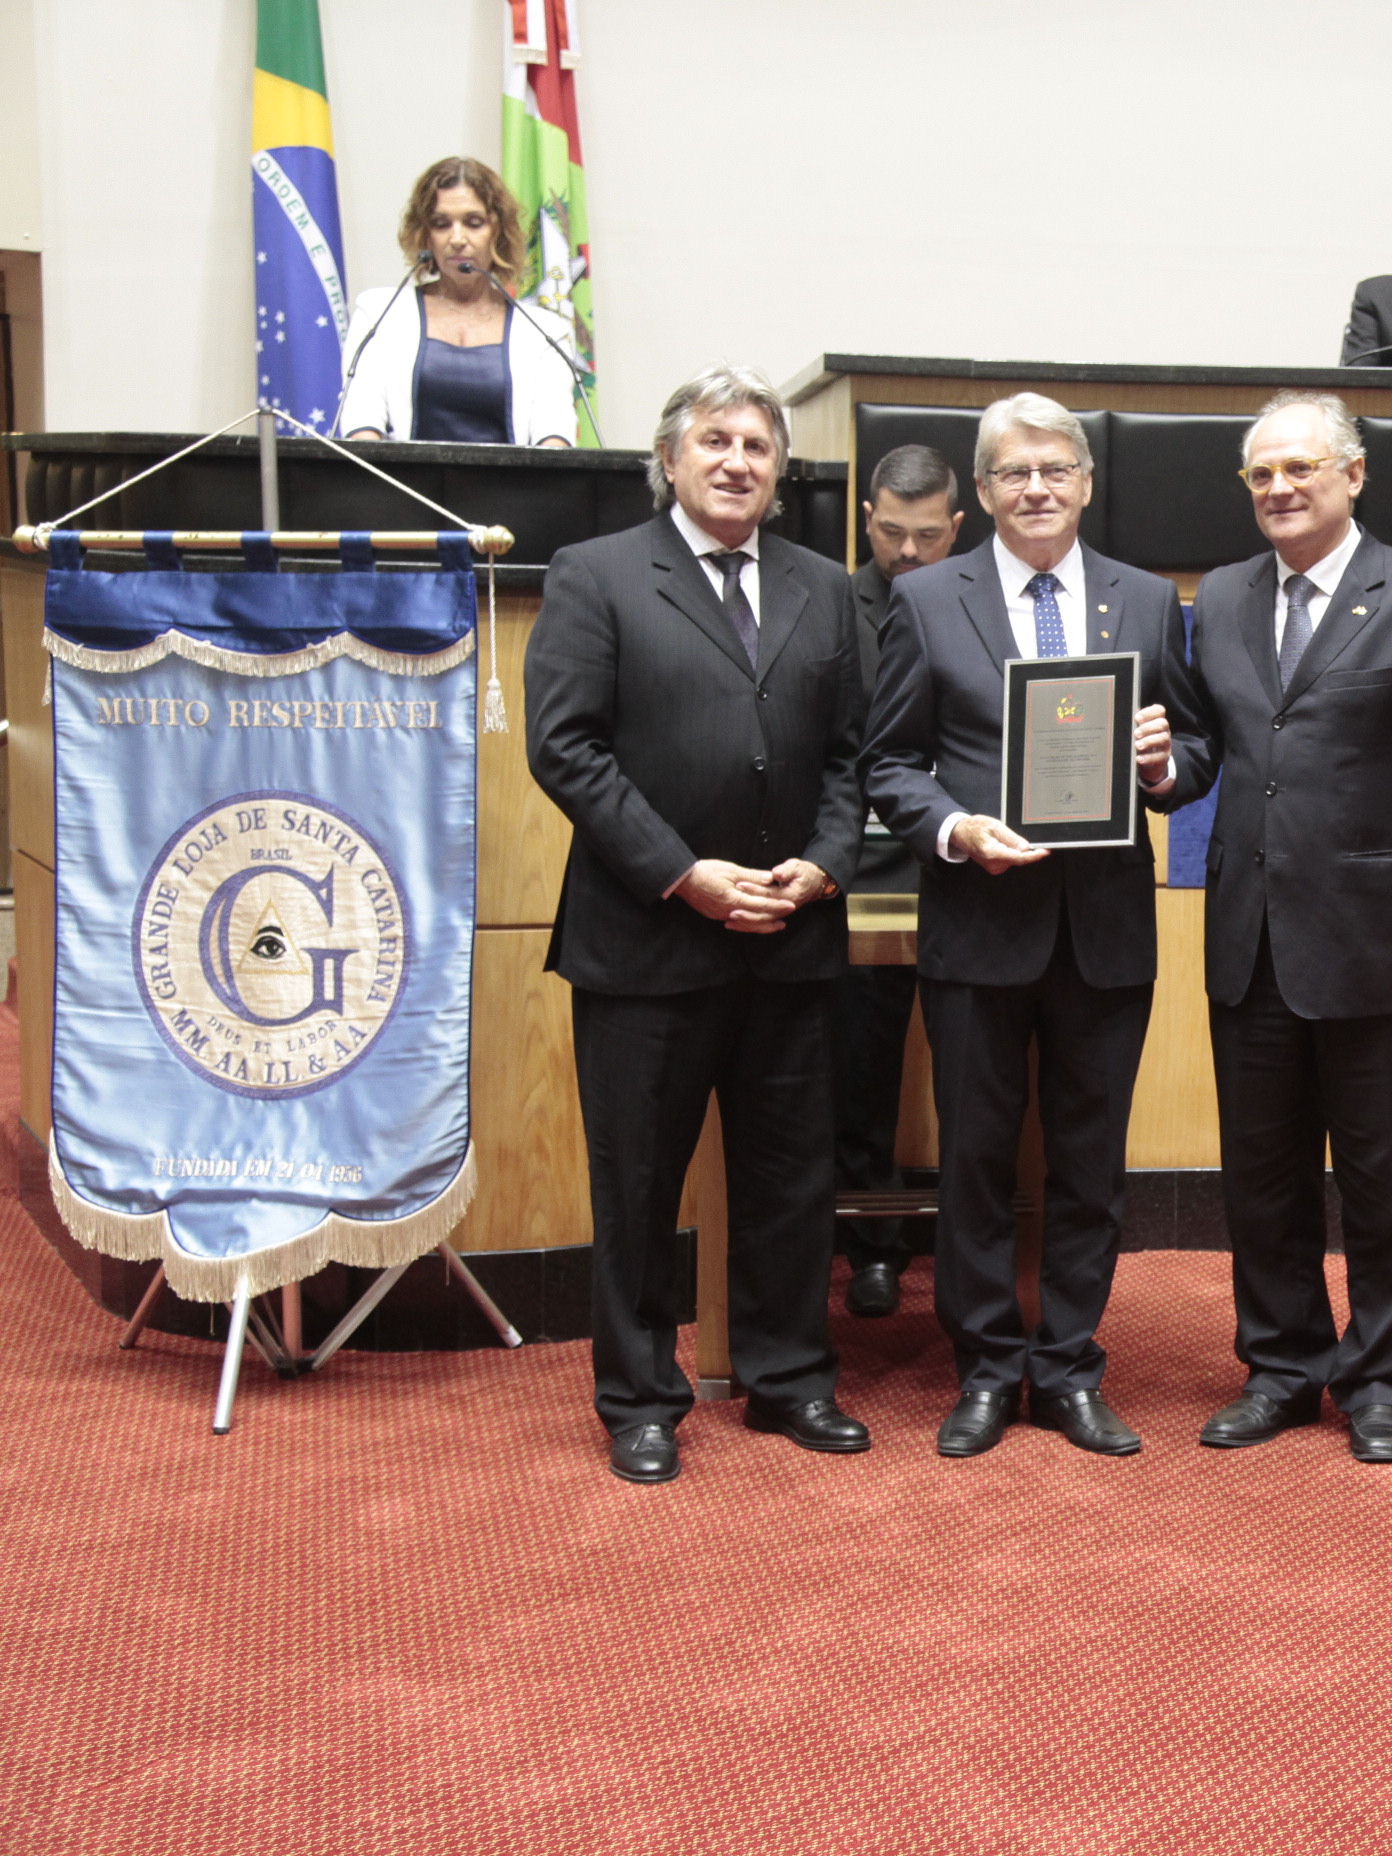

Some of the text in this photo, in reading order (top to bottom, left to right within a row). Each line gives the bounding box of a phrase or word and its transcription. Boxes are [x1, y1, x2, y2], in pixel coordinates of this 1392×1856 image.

[257, 157, 309, 230] ORDEM
[311, 244, 326, 258] E
[96, 696, 444, 729] MUITO RESPEITÁVEL
[250, 849, 293, 861] BRASIL
[149, 808, 398, 1002] GRANDE LOJA DE SANTA CATARINA
[198, 863, 360, 1027] G
[206, 1016, 337, 1055] DEUS ET LABOR
[307, 1053, 327, 1075] &
[153, 1157, 238, 1177] FUNDADA
[243, 1159, 273, 1177] EM
